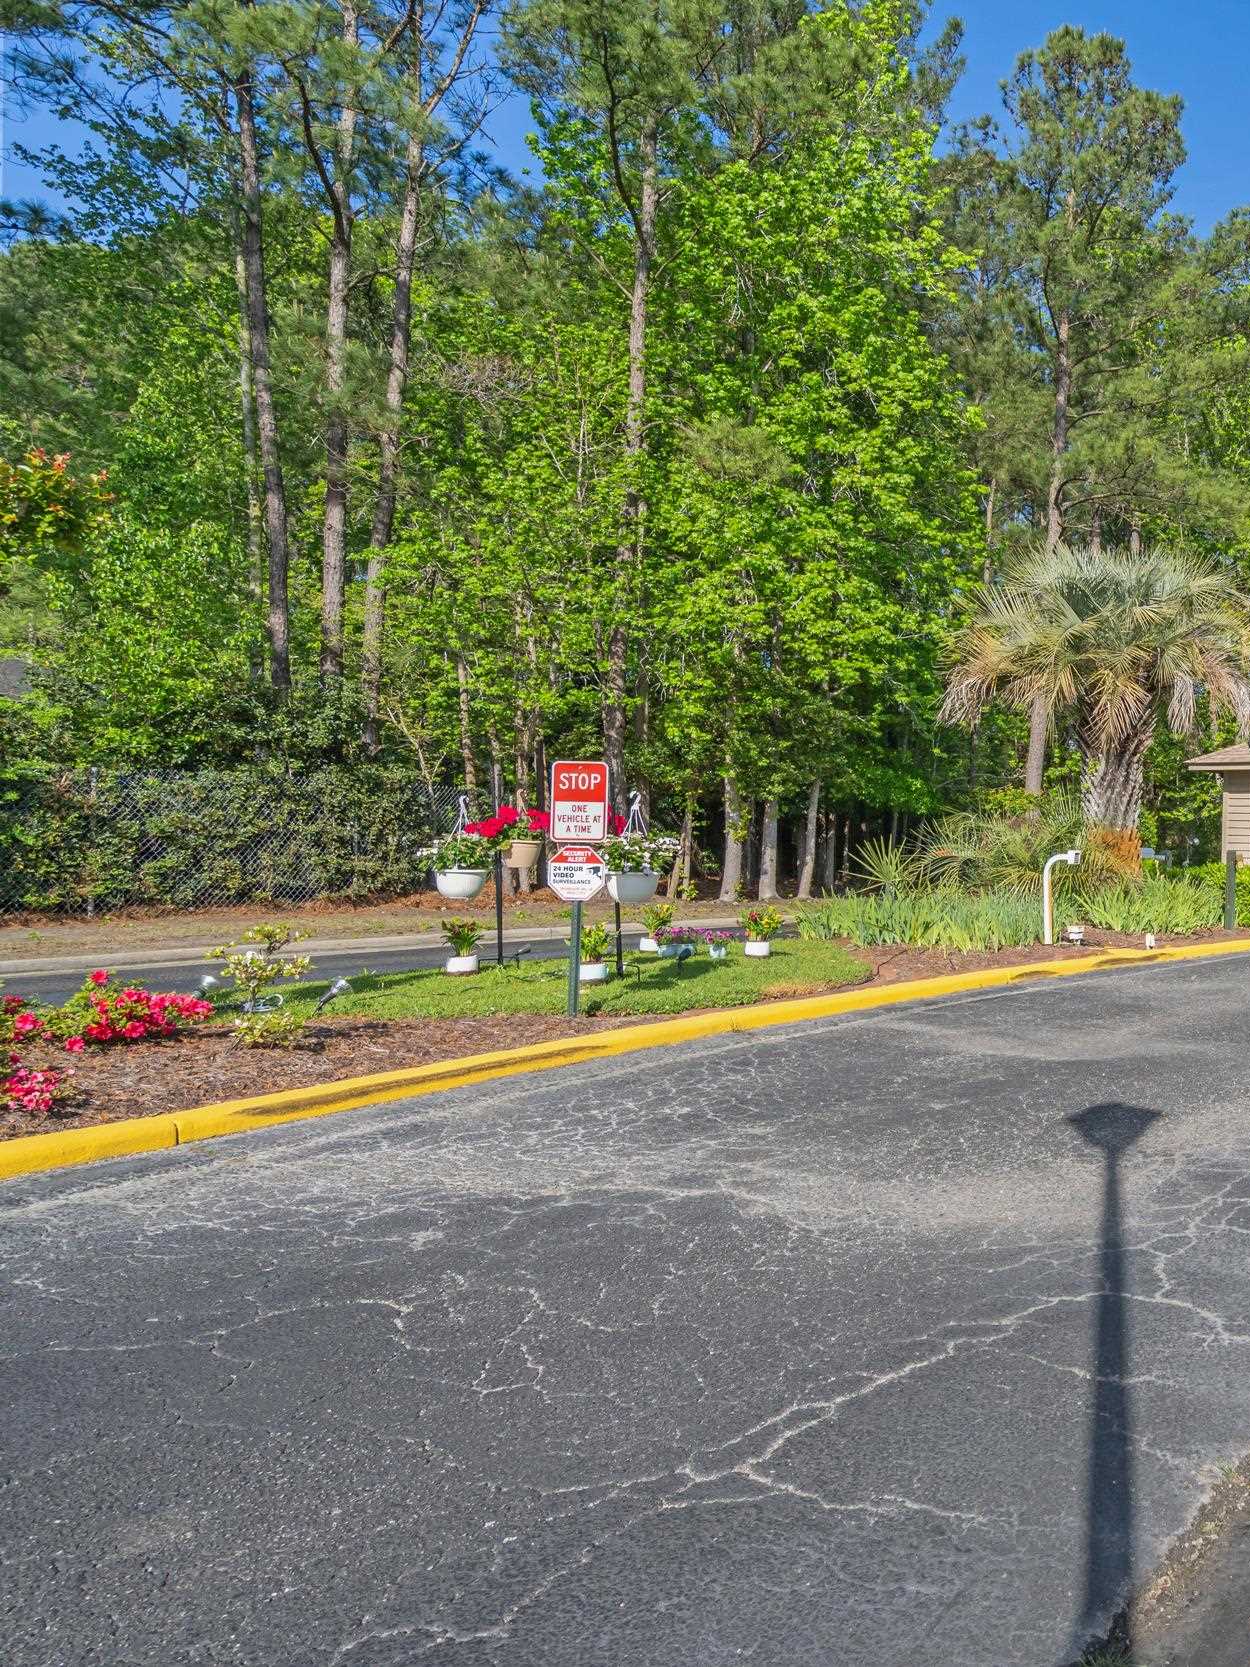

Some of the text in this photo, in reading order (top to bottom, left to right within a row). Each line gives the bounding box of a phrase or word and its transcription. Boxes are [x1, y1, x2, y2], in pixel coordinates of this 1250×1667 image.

[559, 773, 601, 790] STOP
[571, 804, 588, 813] ONE
[557, 814, 601, 824] VEHICLE AT
[566, 825, 592, 834] A TIME
